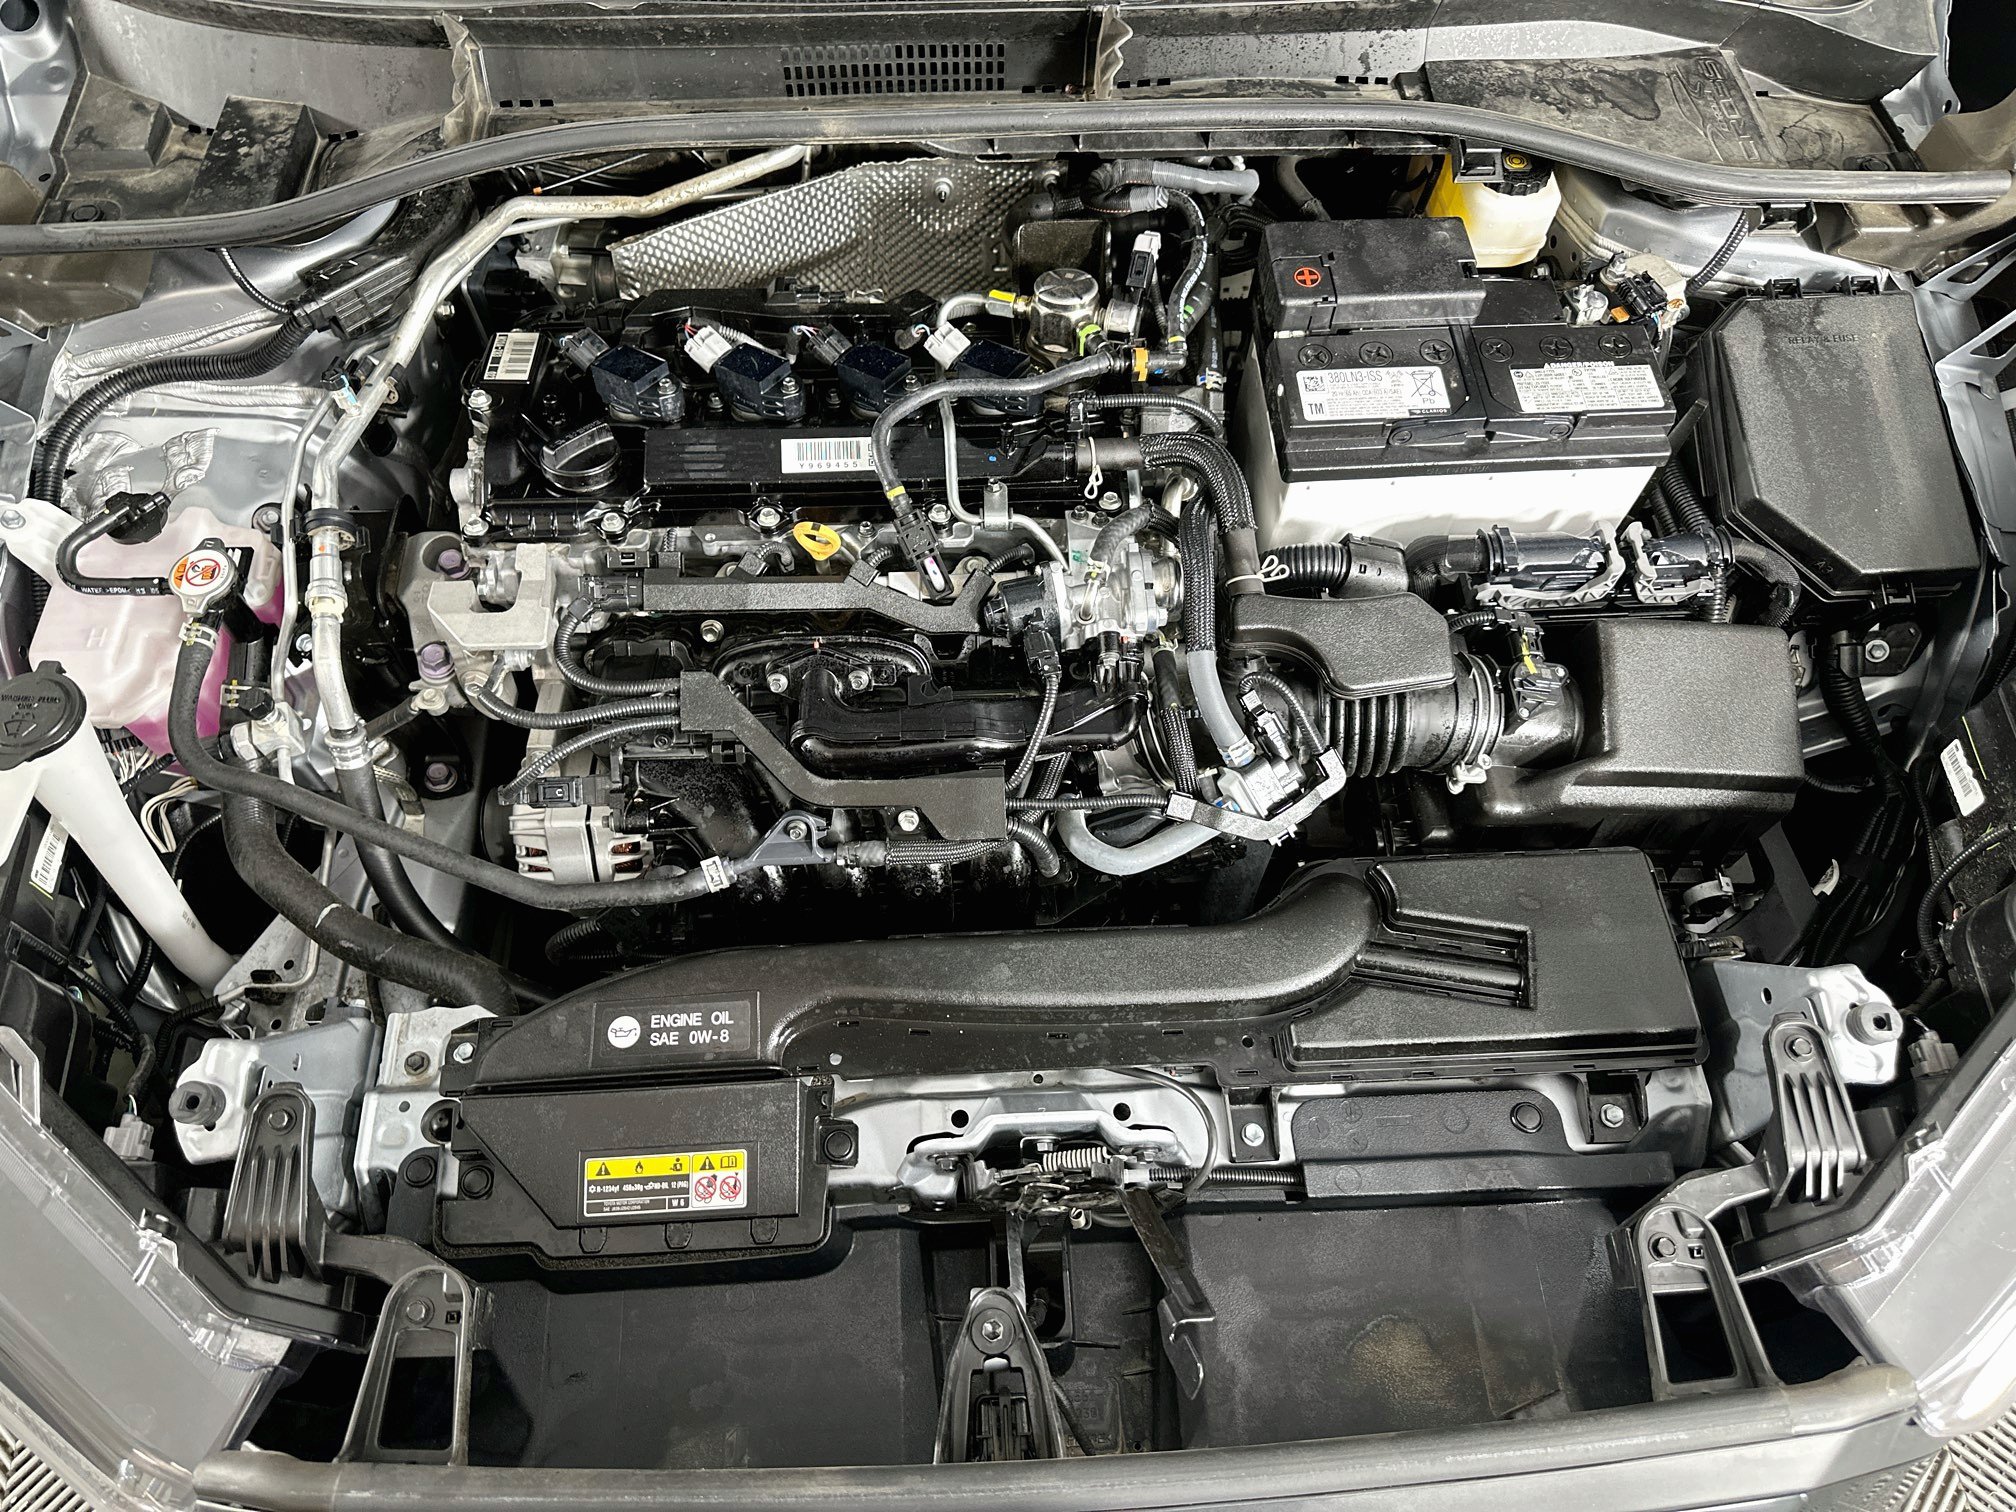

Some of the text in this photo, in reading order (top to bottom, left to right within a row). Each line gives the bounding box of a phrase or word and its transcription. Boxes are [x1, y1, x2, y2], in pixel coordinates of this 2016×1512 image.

[1788, 336, 1820, 344] RELAY
[1327, 370, 1383, 383] 380LN3-ISS
[1308, 403, 1325, 415] TM
[651, 1011, 734, 1028] ENGINE OIL
[650, 1029, 730, 1046] SAE 0W-8
[671, 1199, 680, 1207] W
